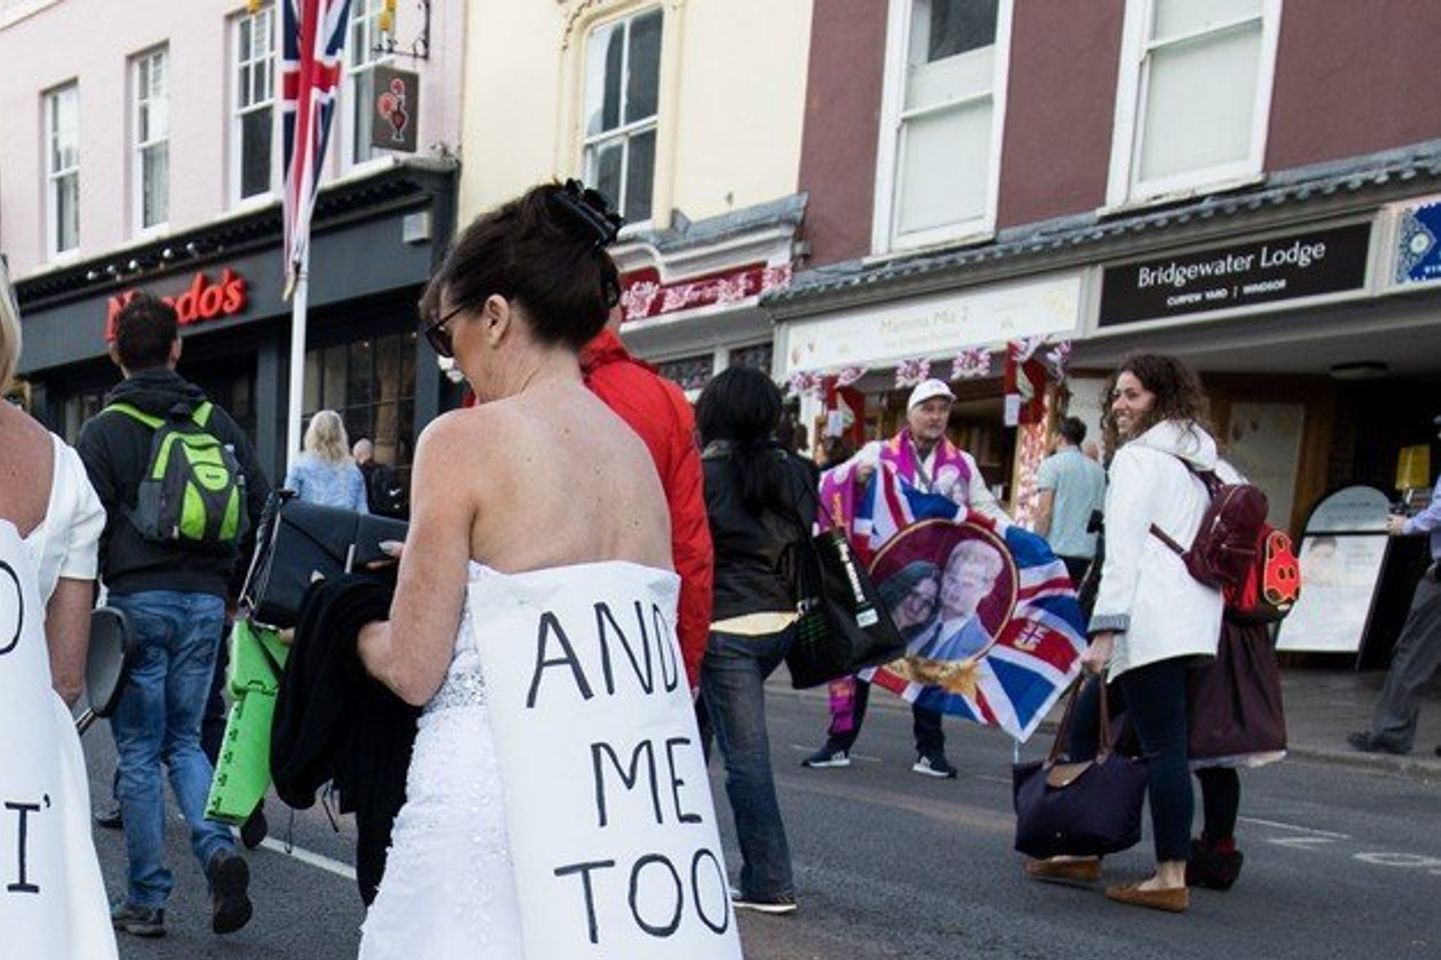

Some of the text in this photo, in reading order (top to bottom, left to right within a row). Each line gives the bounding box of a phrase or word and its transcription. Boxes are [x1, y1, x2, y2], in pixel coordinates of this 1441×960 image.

[105, 266, 246, 343] Ndo's
[1138, 241, 1326, 288] Bridgewater Lodge
[526, 600, 679, 708] AND
[591, 737, 703, 827] ME
[553, 848, 729, 944] TOO
